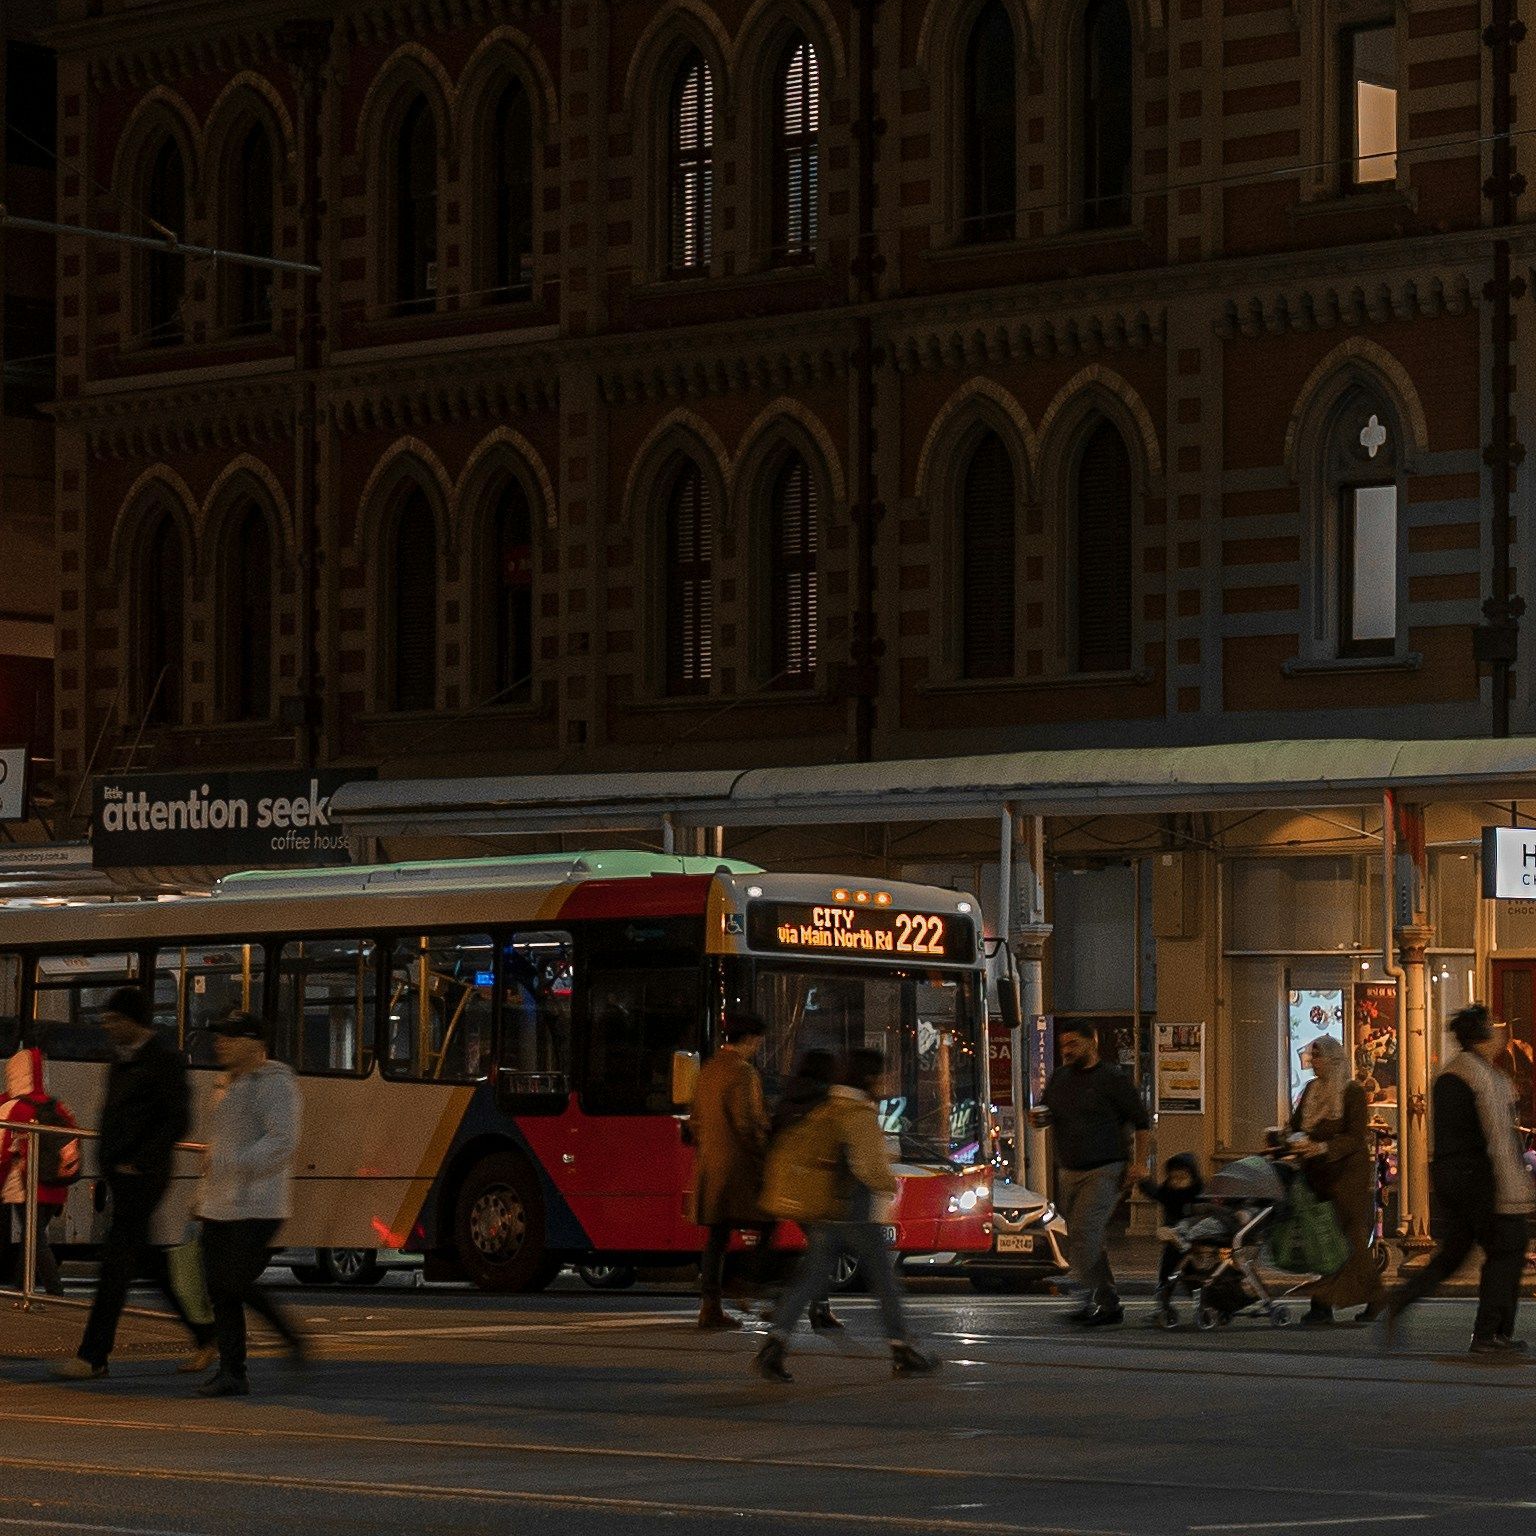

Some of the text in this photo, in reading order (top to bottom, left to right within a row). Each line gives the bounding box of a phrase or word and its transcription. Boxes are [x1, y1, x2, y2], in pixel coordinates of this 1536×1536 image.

[103, 778, 332, 832] attention seek
[270, 829, 311, 851] coffee
[812, 906, 855, 929] CITY
[777, 913, 945, 955] via Main North Rd 222
